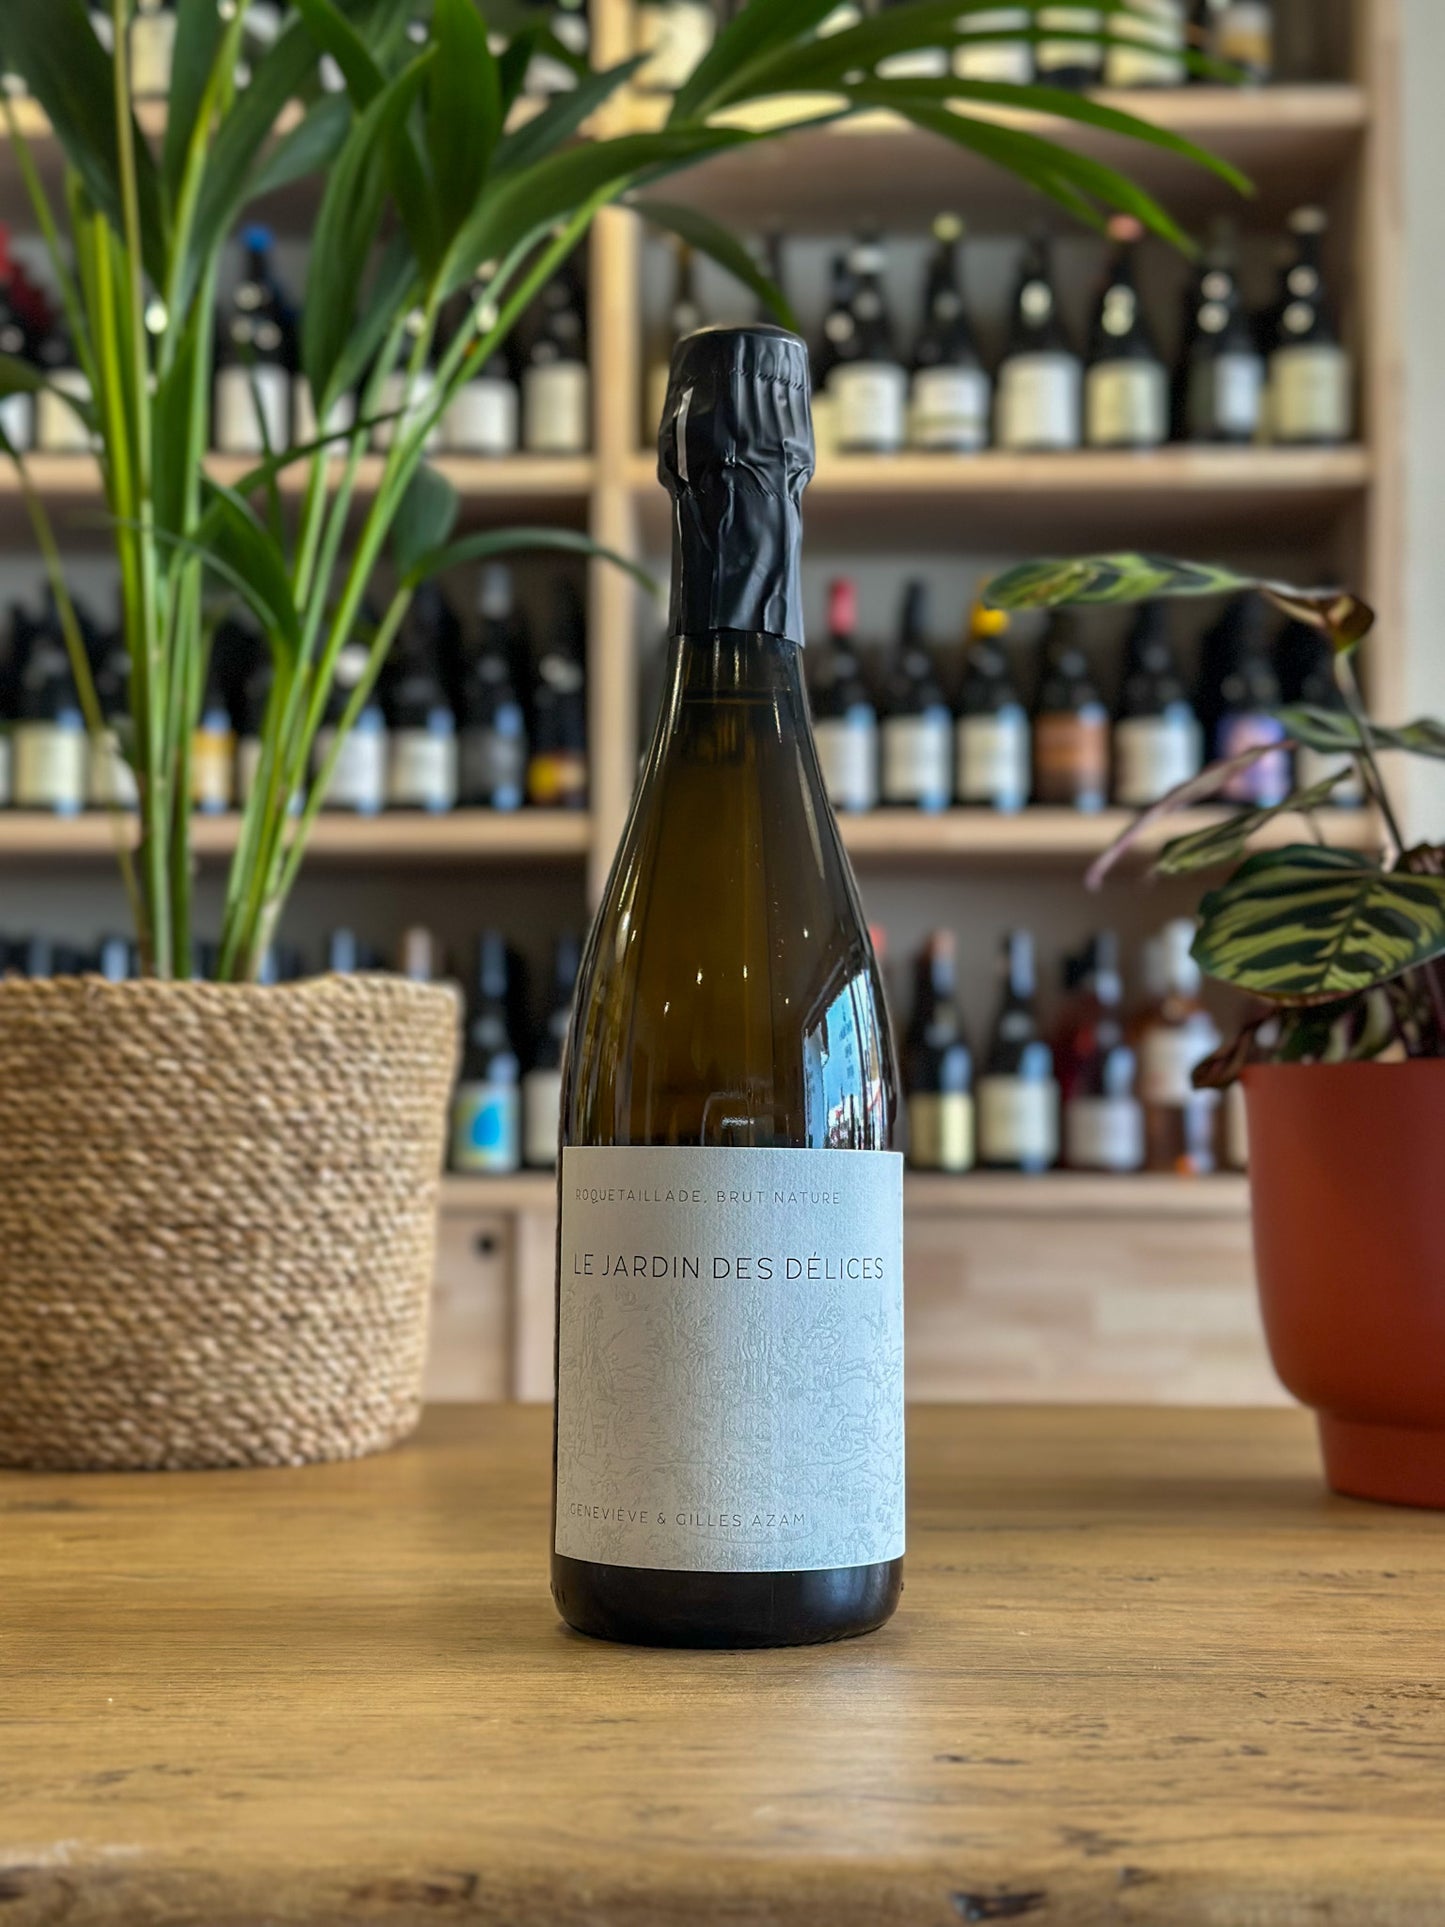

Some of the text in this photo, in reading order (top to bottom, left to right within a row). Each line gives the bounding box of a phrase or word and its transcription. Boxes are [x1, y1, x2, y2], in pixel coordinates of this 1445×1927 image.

[575, 1187, 841, 1205] ROQUETAILLADE, BRUT NATURE
[574, 1251, 885, 1280] LE JARDIN DES DÉLICES
[656, 1512, 668, 1525] &
[675, 1513, 742, 1527] GILLES
[751, 1513, 806, 1527] AZAM
